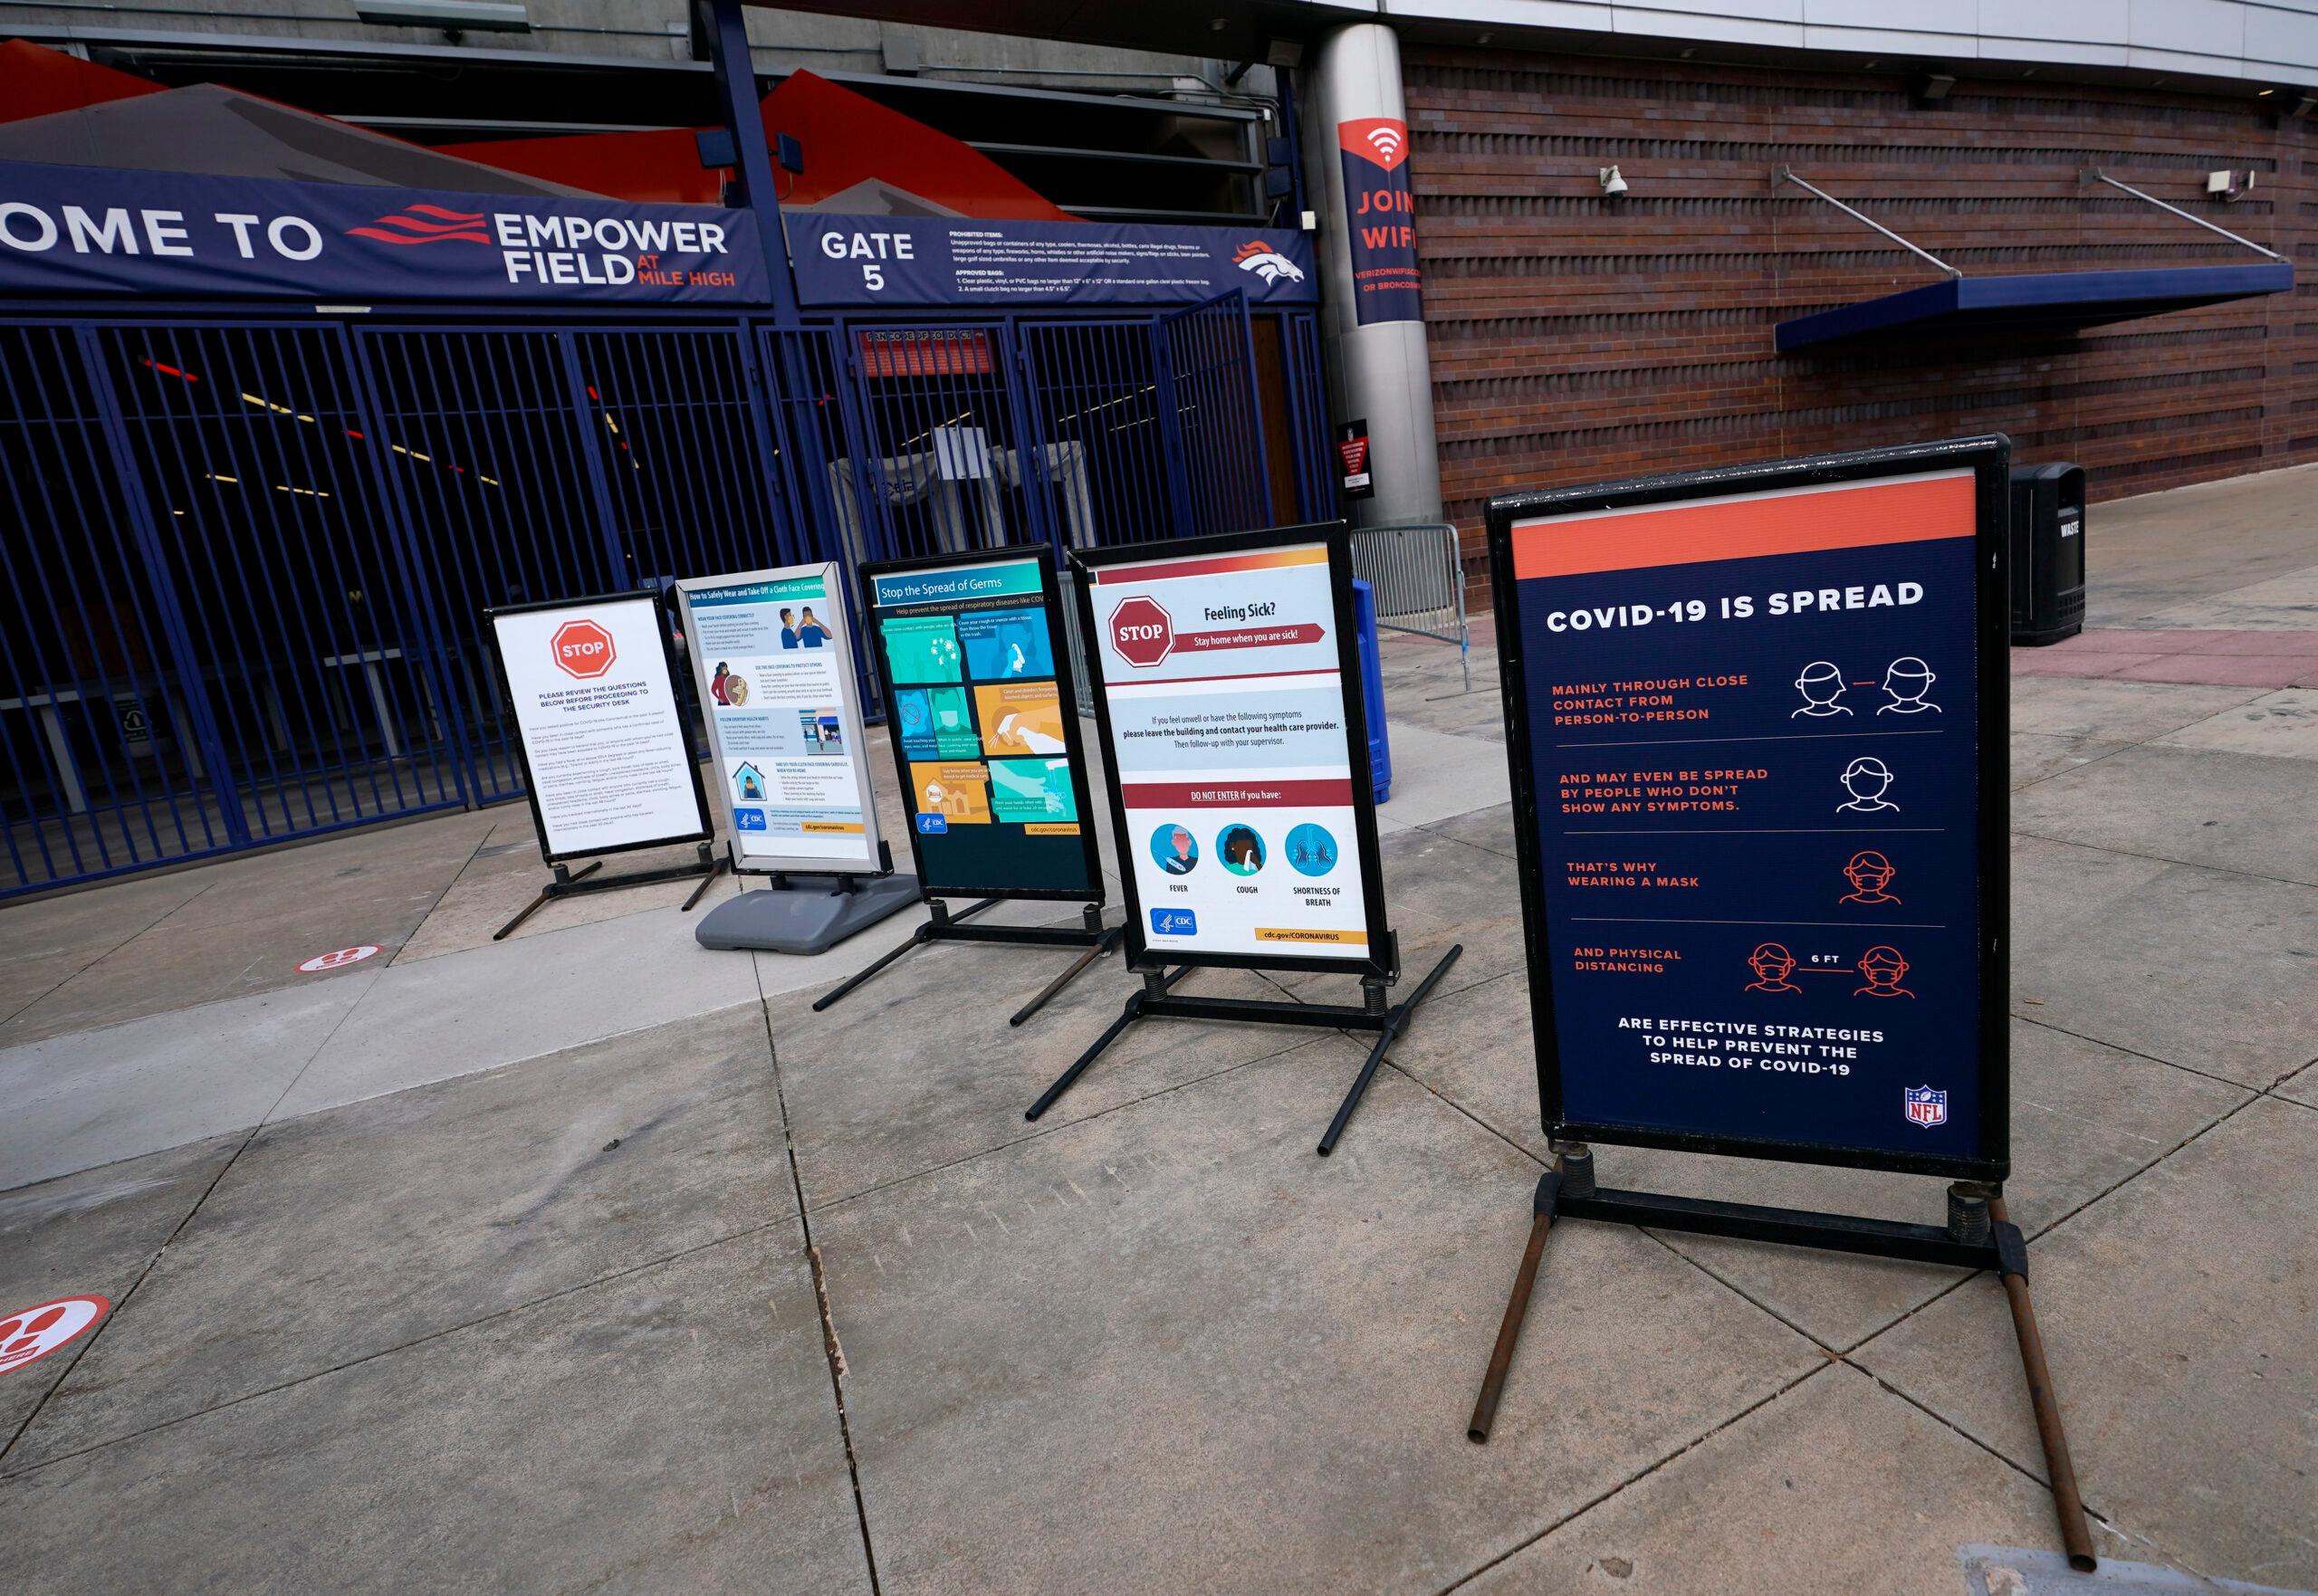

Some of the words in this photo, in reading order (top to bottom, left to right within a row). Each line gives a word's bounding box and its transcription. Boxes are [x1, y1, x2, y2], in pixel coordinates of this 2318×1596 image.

[1357, 190, 1413, 214] JOIN
[215, 214, 322, 261] TO
[494, 214, 728, 253] EMPOWER
[822, 232, 914, 259] GATE
[505, 251, 635, 284] FIELD
[637, 254, 658, 269] AT
[638, 272, 684, 285] MILE
[689, 272, 735, 286] HIGH
[863, 265, 884, 291] 5
[888, 330, 915, 341] COE
[2061, 521, 2079, 537] WASTE
[882, 588, 903, 599] Stop
[905, 586, 920, 596] the
[923, 581, 955, 596] Spread
[958, 580, 967, 590] of
[970, 579, 1001, 589] Germs
[909, 607, 929, 615] prevent
[940, 603, 958, 612] spread
[965, 601, 994, 609] respiratory
[1204, 606, 1246, 621] Feeling
[1248, 602, 1275, 616] Sick?
[1547, 600, 1706, 632] COVID-19
[1721, 596, 1754, 618] IS
[1768, 582, 1923, 615] SPREAD
[1120, 625, 1163, 641] STOP
[1194, 637, 1210, 647] Stay
[1211, 636, 1231, 645] home
[1232, 634, 1252, 643] when
[1254, 635, 1268, 644] you
[1282, 630, 1298, 639] sick!
[562, 642, 604, 657] STOP
[608, 682, 647, 691] QUESTIONS
[1552, 683, 1606, 695] MAINLY
[1613, 679, 1690, 692] THROUGH
[1696, 675, 1748, 687] CLOSE
[594, 691, 637, 701] PROCEEDING
[1554, 698, 1623, 711] CONTACT
[1630, 695, 1672, 706] FROM
[578, 702, 610, 711] SECURITY
[1157, 718, 1168, 726] you
[1169, 715, 1181, 723] feel
[1182, 714, 1202, 723] unwell
[1238, 712, 1268, 722] following
[1269, 712, 1302, 721] symptoms
[1555, 710, 1709, 725] PERSON-TO-PERSON
[1124, 731, 1144, 740] please
[1176, 728, 1204, 737] building
[1220, 726, 1245, 734] contact
[1306, 722, 1338, 732] provider.
[1190, 741, 1219, 749] follow-up
[1235, 740, 1249, 748] your
[1250, 738, 1282, 747] supervisor.
[1560, 774, 1590, 783] AND
[1596, 773, 1626, 782] MAY
[1633, 772, 1672, 781] EVEN
[1680, 771, 1698, 780] BE
[1705, 769, 1767, 779] SPREAD
[1191, 792, 1201, 800] DO
[1202, 791, 1215, 800] NOT
[1217, 791, 1240, 800] ENTER
[1240, 790, 1245, 799] if
[1261, 790, 1281, 798] have:
[1561, 789, 1578, 798] BY
[1585, 788, 1641, 798] PEOPLE
[1646, 787, 1682, 797] WHO
[1562, 804, 1604, 813] SHOW
[1611, 803, 1641, 812] ANY
[1648, 801, 1738, 811] SYMPTOMS.
[1623, 863, 1656, 872] WHY
[1568, 877, 1635, 886] WEARING
[1642, 877, 1651, 886] A
[1657, 877, 1699, 886] MASK
[1264, 932, 1339, 940] cdc.gov/CORONAVIRUS
[1575, 948, 1604, 957] AND
[1610, 949, 1681, 959] PHYSICAL
[1825, 955, 1839, 963] FT
[1576, 961, 1663, 972] DISTANCING
[1619, 1018, 1652, 1029] ARE
[1660, 1019, 1757, 1035] EFFECTIVE
[1765, 1025, 1883, 1042] STRATEGIES
[1643, 1036, 1665, 1046] TO
[1673, 1037, 1718, 1049] HELP
[1726, 1040, 1811, 1056] PREVENT
[1819, 1046, 1856, 1058] THE
[1651, 1053, 1721, 1066] SPREAD
[1729, 1057, 1752, 1068] OF
[1760, 1059, 1850, 1075] COVID-19
[1909, 1103, 1943, 1122] NFL
